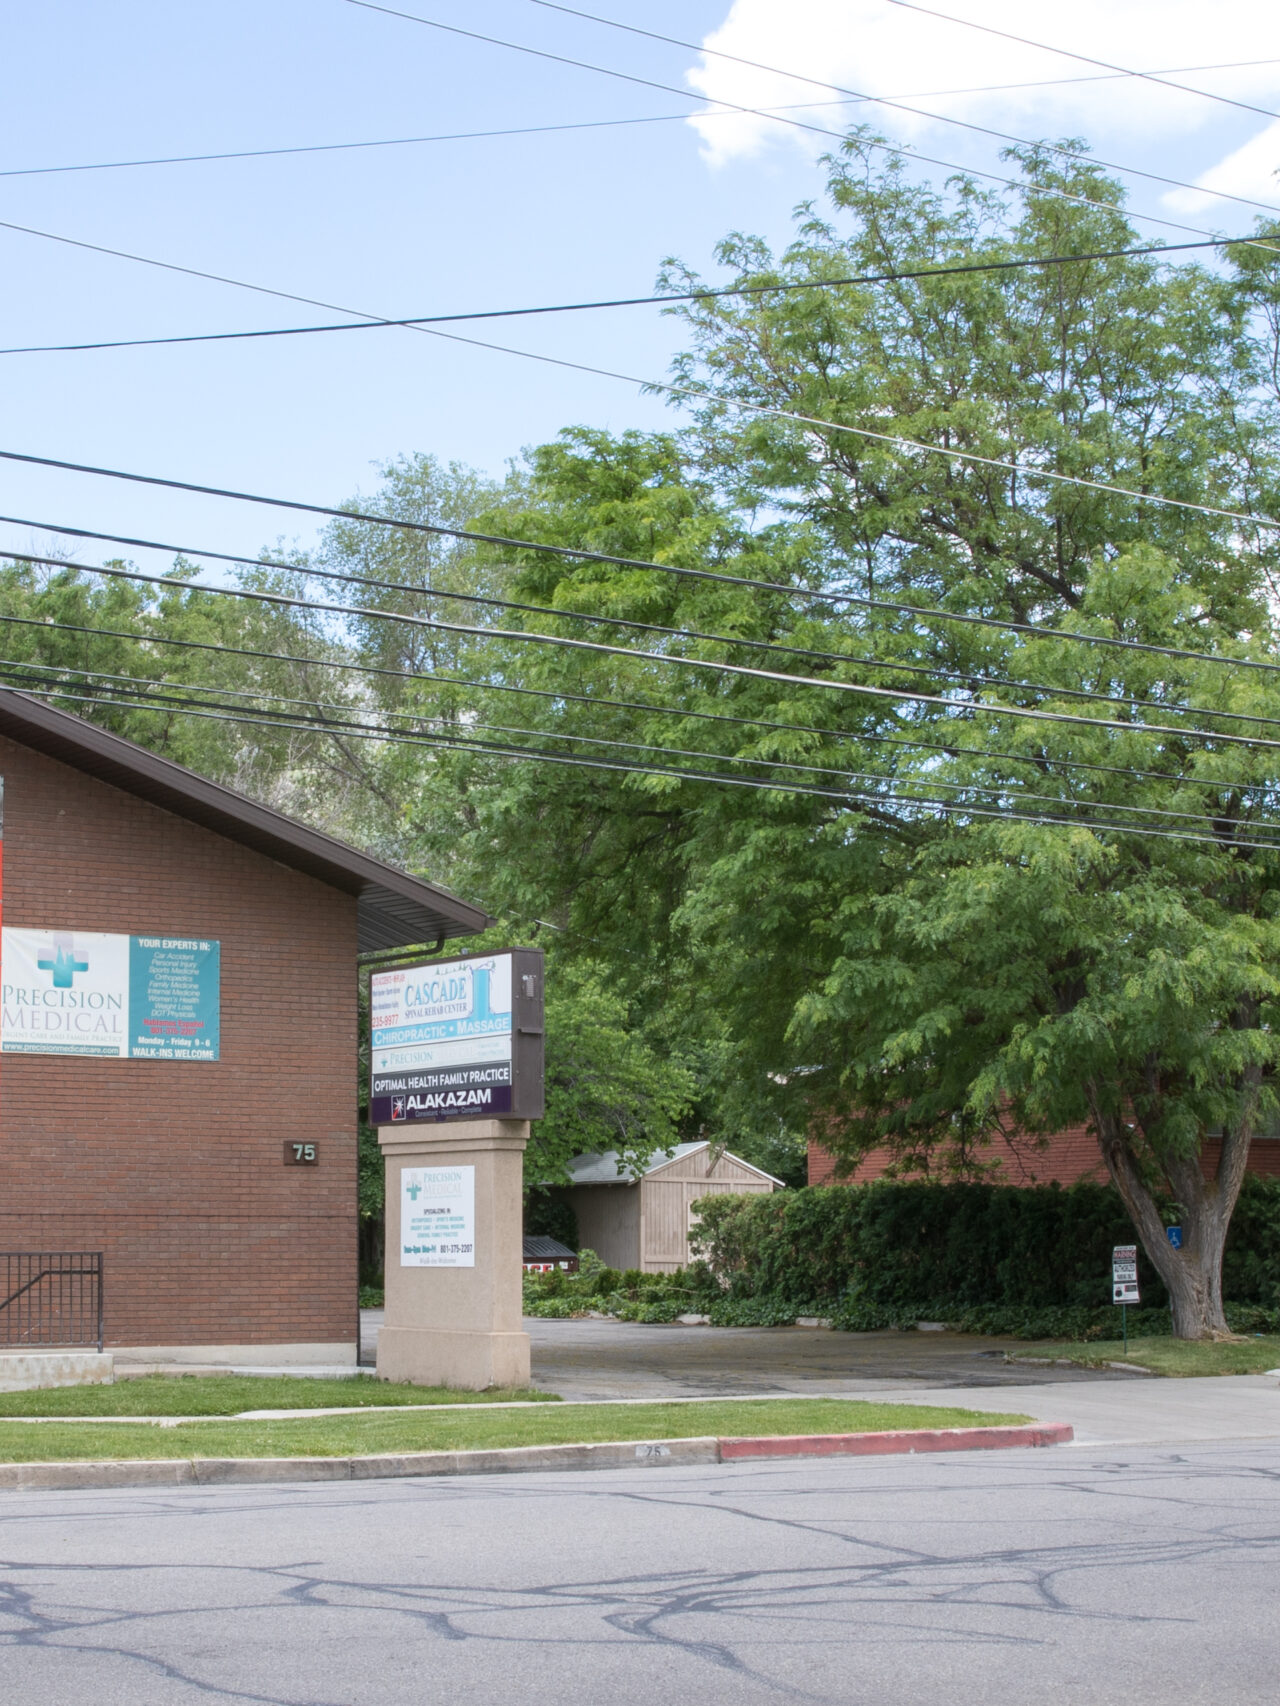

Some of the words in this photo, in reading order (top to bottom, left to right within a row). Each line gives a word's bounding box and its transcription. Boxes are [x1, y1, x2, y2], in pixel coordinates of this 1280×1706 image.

[138, 938, 160, 948] YOUR
[162, 939, 197, 950] EXPERTS
[200, 941, 210, 951] IN:
[153, 951, 166, 959] Car
[167, 953, 194, 961] Accident
[151, 959, 179, 967] Personal
[180, 960, 198, 969] Injury
[149, 966, 170, 974] Sports
[171, 968, 199, 976] Medicine
[154, 973, 193, 983] Orthopedics
[149, 980, 169, 989] Family
[170, 981, 199, 990] Medicine
[2, 984, 122, 1010] PRECISION
[147, 988, 171, 996] Internal
[172, 989, 200, 997] Medicine
[404, 977, 467, 1007] CASCADE
[179, 996, 199, 1004] Health
[154, 1002, 177, 1011] Weight
[177, 1003, 193, 1011] Loss
[404, 1009, 423, 1020] SPINAL
[424, 1006, 443, 1017] REHAB
[443, 1002, 467, 1014] CENTER
[1, 1007, 124, 1034] MEDICAL
[374, 1024, 446, 1045] CHIROPRACTIC
[457, 1017, 510, 1034] MASSAGE
[138, 1036, 165, 1046] Monday
[170, 1037, 192, 1047] Friday
[132, 1047, 173, 1058] WALK-INS
[174, 1049, 214, 1059] WELCOME
[374, 1079, 407, 1092] OPTIMAL
[408, 1075, 438, 1089] HEALTH
[440, 1072, 468, 1086] FAMILY
[469, 1067, 509, 1082] PRACTICE
[406, 1088, 491, 1110] ALAKAZAM
[292, 1144, 315, 1160] 75
[423, 1172, 462, 1183] PRECISION
[646, 1446, 661, 1457] 75
